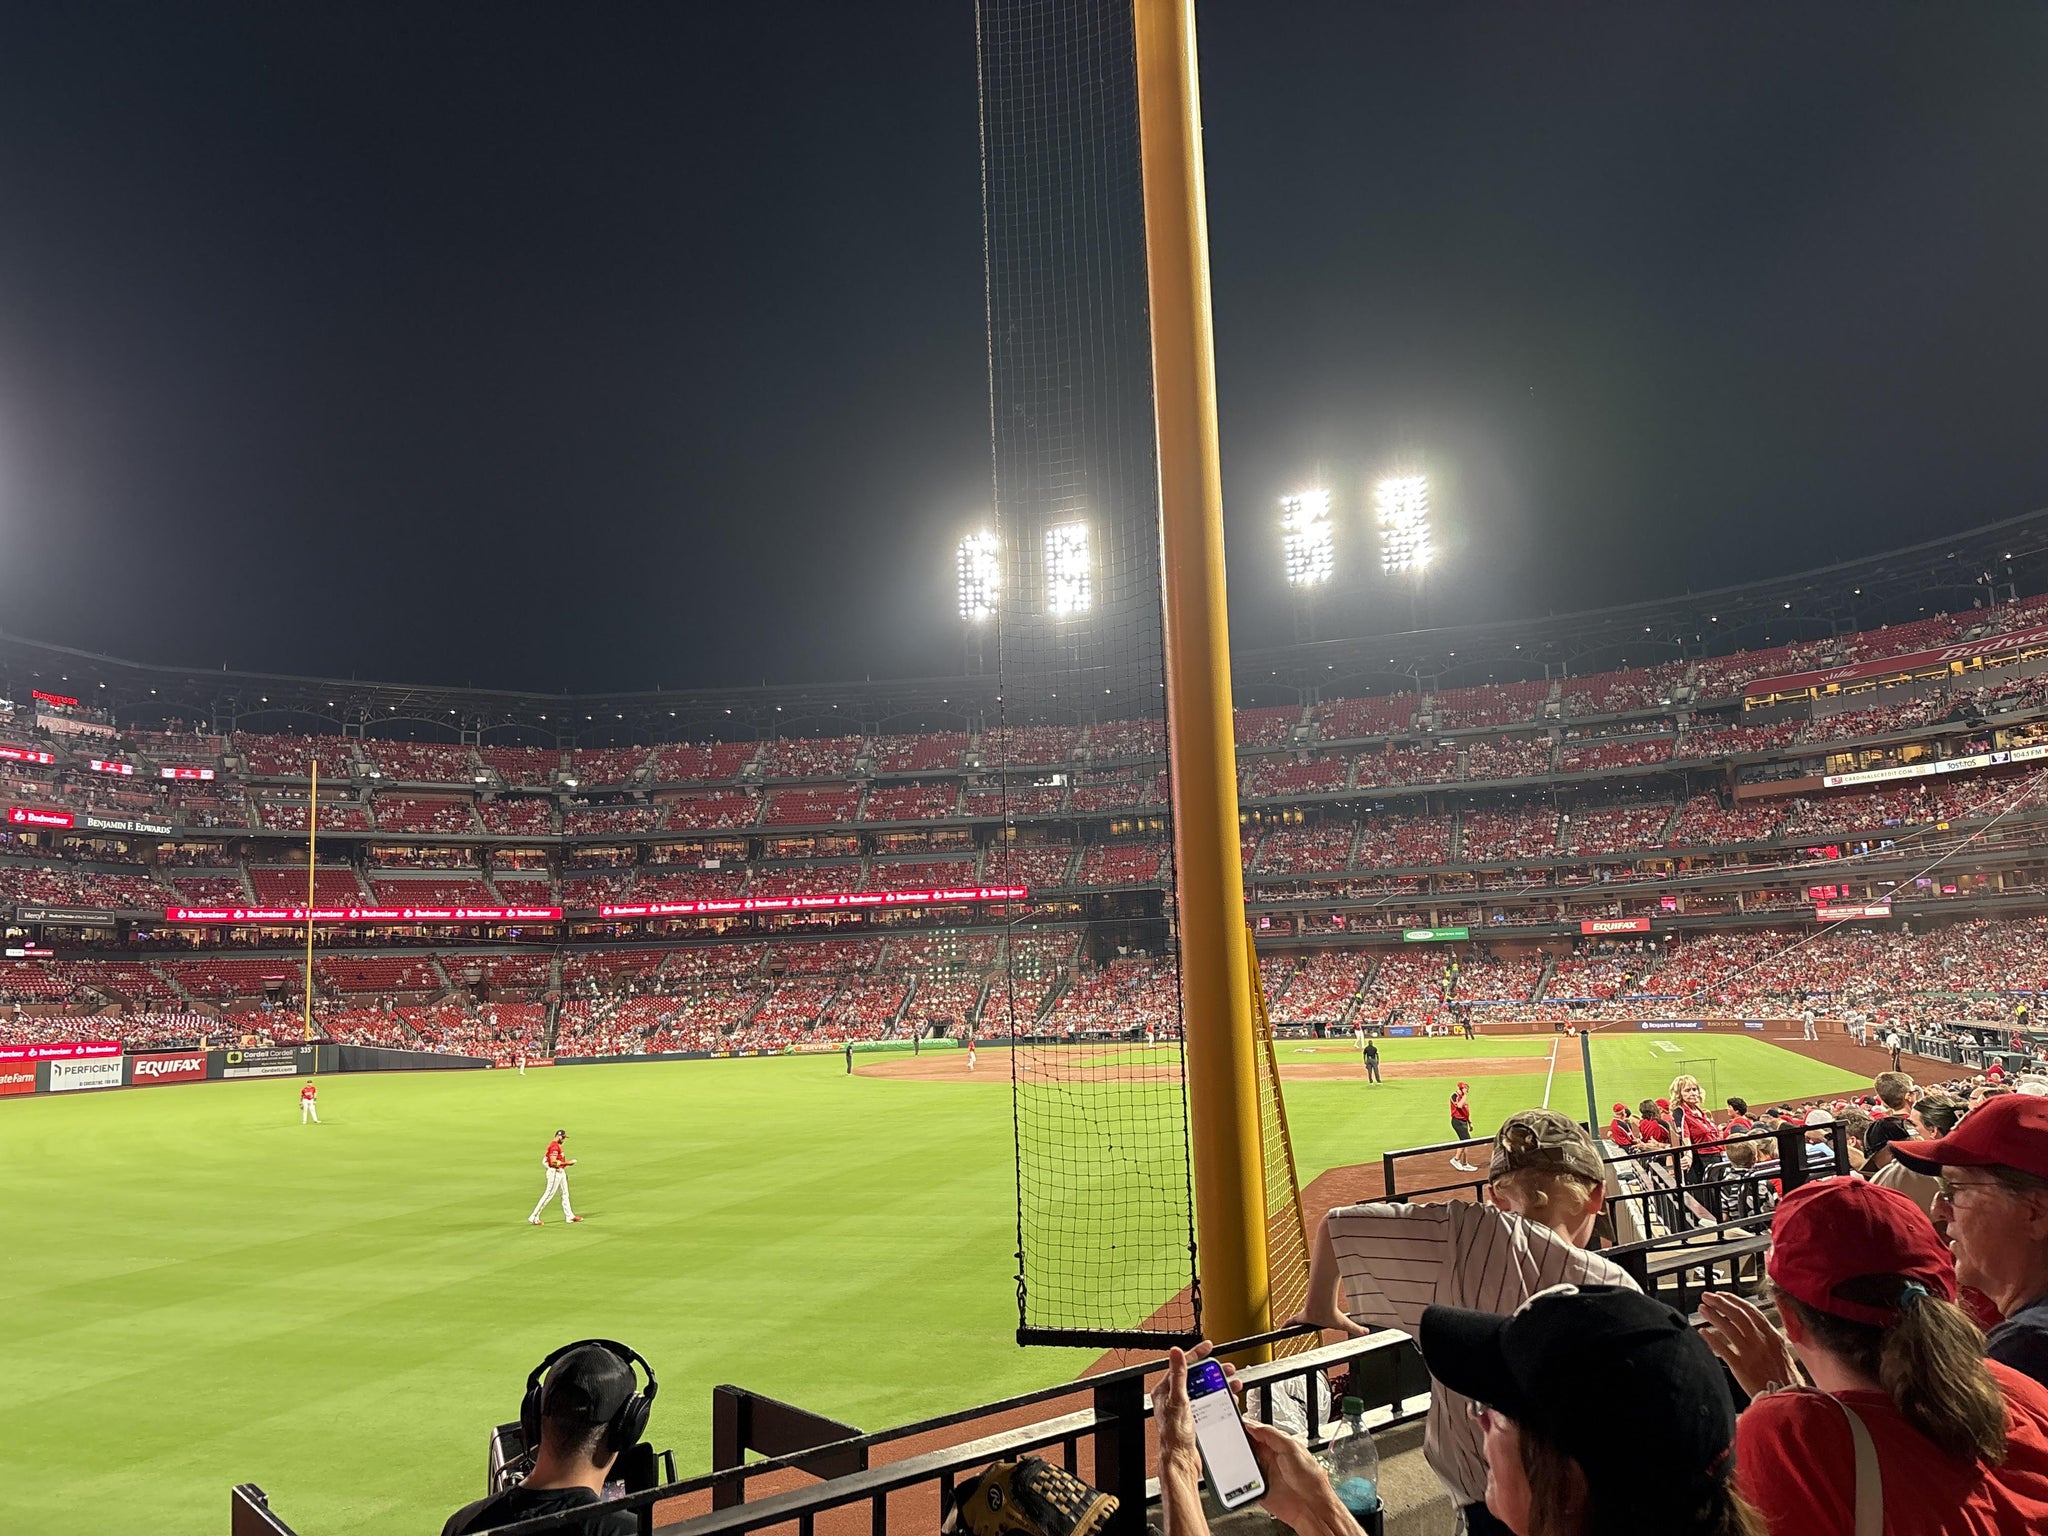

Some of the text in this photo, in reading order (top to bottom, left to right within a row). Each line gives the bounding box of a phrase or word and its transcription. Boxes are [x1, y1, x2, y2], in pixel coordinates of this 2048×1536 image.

[32, 689, 78, 705] BUDWEISER
[28, 812, 69, 825] Budweiser
[87, 817, 127, 830] BENJAMIN
[135, 822, 171, 834] EDWARDS
[24, 912, 40, 920] Mercy
[1593, 922, 1637, 932] EQUIFAX
[269, 1049, 293, 1057] Cordell
[64, 1063, 121, 1075] PERFICIENT
[134, 1058, 202, 1077] EQUIFAX
